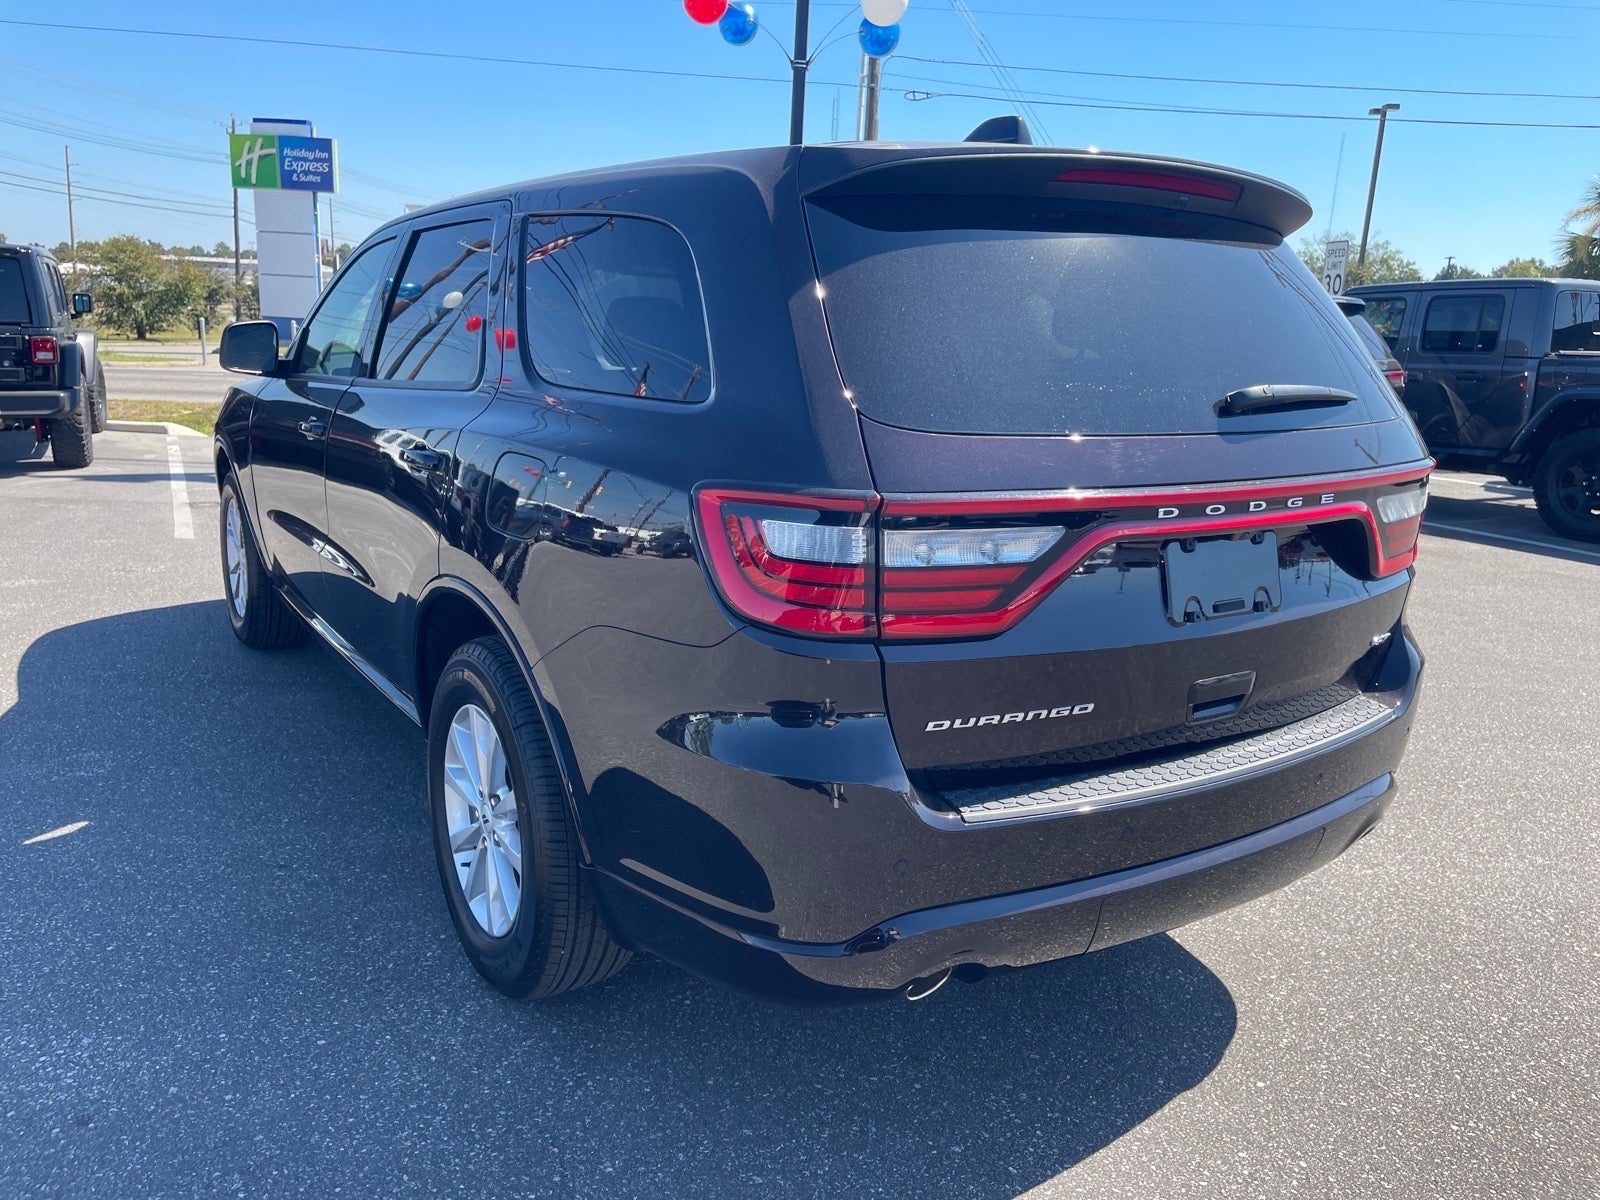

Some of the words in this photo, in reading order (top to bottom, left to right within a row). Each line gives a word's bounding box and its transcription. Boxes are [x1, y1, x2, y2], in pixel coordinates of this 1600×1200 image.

[283, 147, 314, 160] Holiday
[315, 149, 329, 159] Inn
[284, 158, 329, 173] Express
[292, 172, 298, 182] &
[299, 173, 321, 183] Suites
[1326, 248, 1347, 258] SPEED
[1326, 260, 1343, 271] LIMIT
[1324, 273, 1342, 295] 30
[1157, 493, 1335, 519] DODGE
[924, 702, 1095, 732] DURANGO
